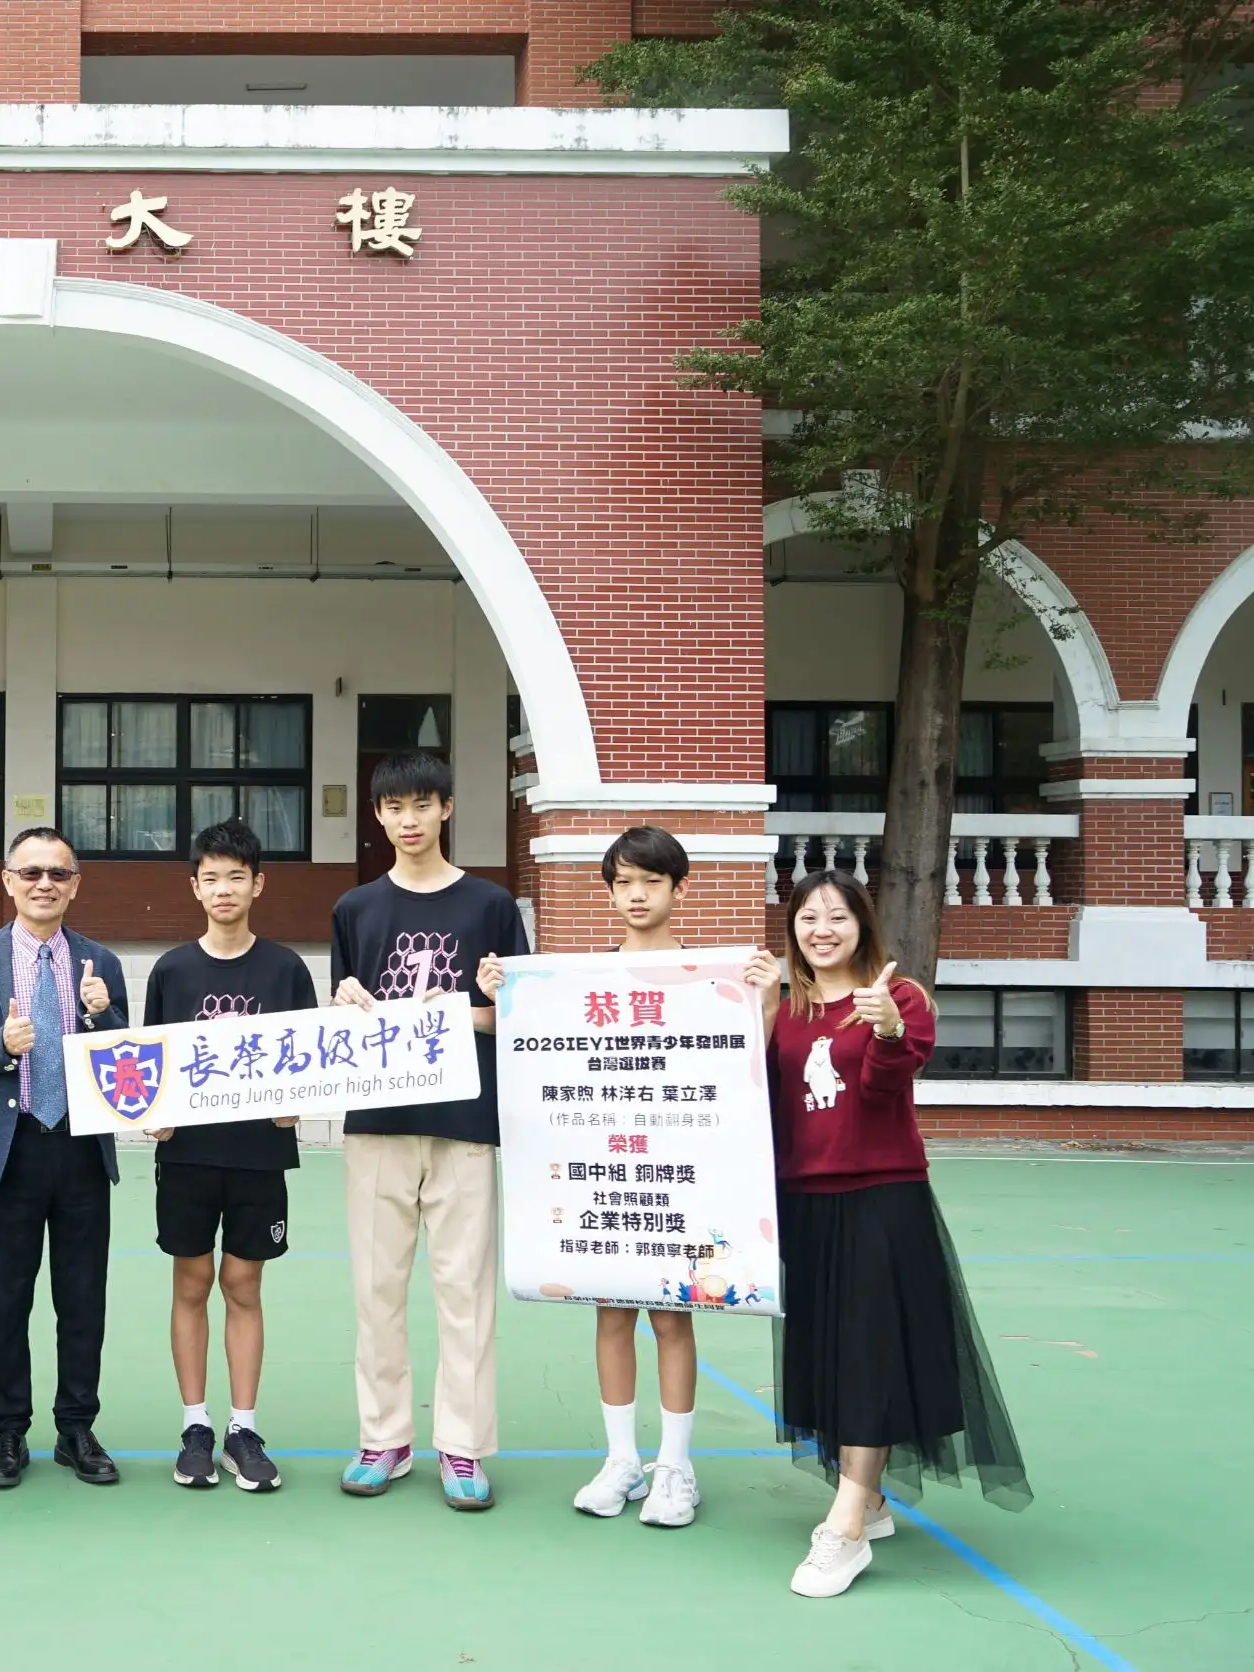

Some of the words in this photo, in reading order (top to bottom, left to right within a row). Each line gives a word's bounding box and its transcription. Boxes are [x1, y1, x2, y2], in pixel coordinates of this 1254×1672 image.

[584, 991, 666, 1027] 恭賀
[179, 1010, 450, 1088] 長榮高級中學
[587, 1056, 667, 1072] 台灣選拔賽
[189, 1091, 240, 1109] Chang
[244, 1086, 283, 1104] Jung
[290, 1080, 341, 1099] senior
[346, 1075, 383, 1096] high
[389, 1068, 444, 1088] school
[542, 1085, 594, 1102] 陳家煦
[601, 1085, 654, 1102] 林洋右
[662, 1085, 717, 1102] 葉立澤
[608, 1134, 649, 1154] 榮獲
[568, 1162, 627, 1182] 國中組
[635, 1164, 696, 1184] 銅牌獎
[592, 1191, 670, 1208] 社會照顧類
[579, 1210, 686, 1233] 企業特別獎
